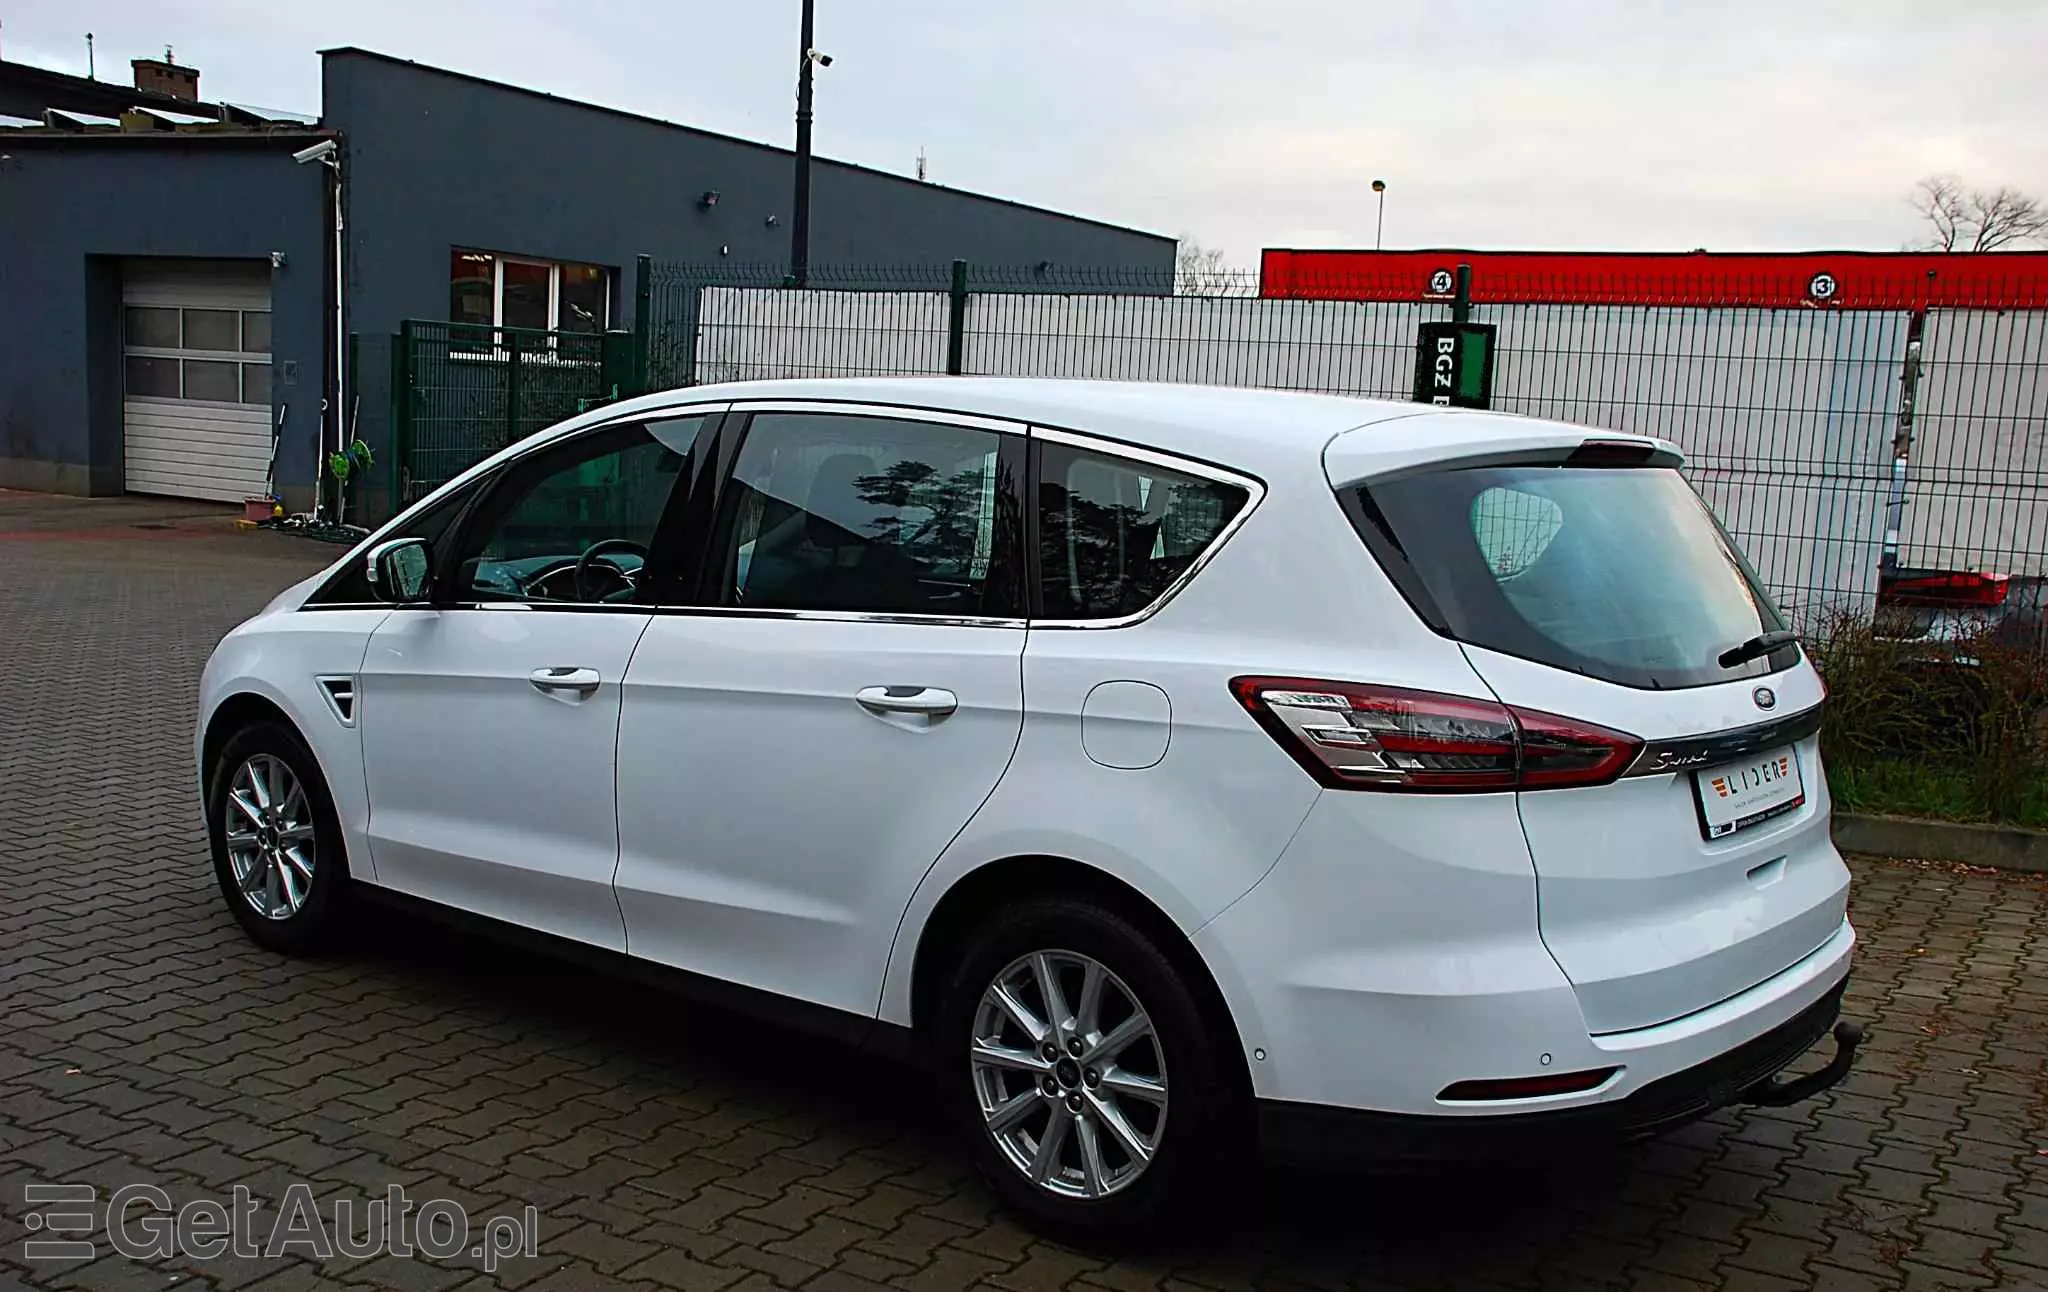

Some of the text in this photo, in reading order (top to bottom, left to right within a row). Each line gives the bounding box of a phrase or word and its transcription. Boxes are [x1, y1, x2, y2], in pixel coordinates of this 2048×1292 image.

[1436, 274, 1447, 290] 4
[1816, 278, 1829, 294] 3
[1726, 760, 1781, 795] LIDER
